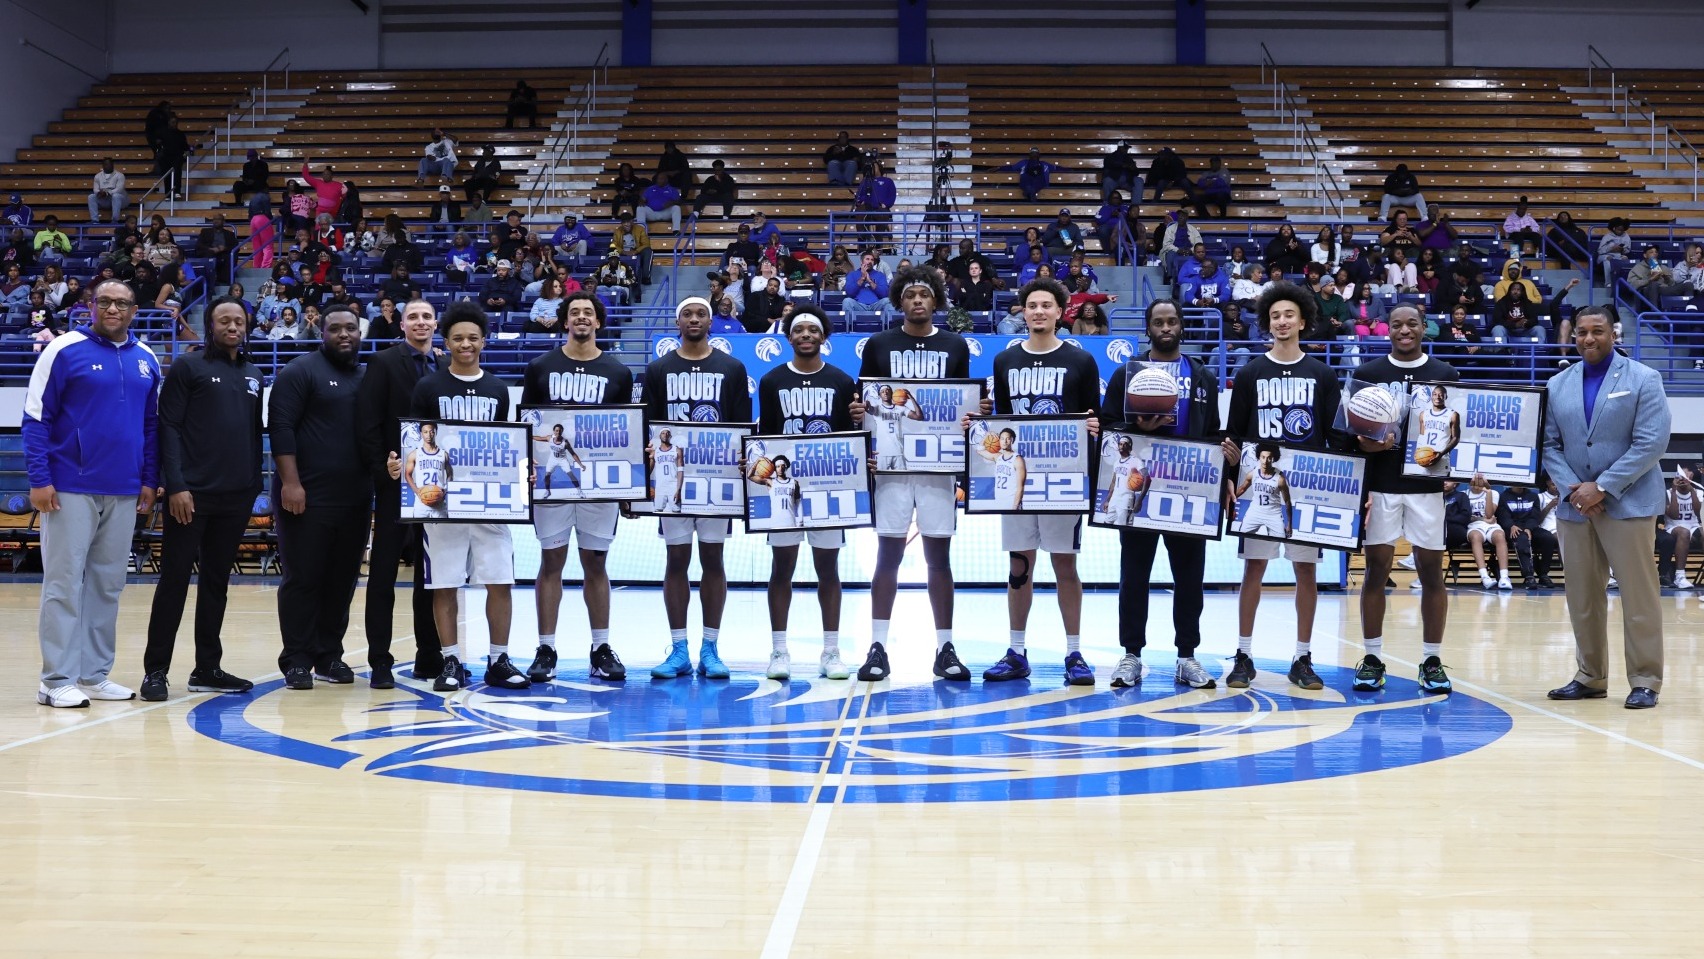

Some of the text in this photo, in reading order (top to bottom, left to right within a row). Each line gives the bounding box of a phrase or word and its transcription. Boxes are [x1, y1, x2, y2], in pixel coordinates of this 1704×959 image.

[889, 350, 949, 379] DOUBT
[548, 372, 609, 404] DOUBT
[666, 372, 725, 402] DOUBT
[1008, 367, 1068, 397] DOUBT
[1256, 377, 1316, 407] DOUBT
[438, 396, 498, 420] DOUBT
[778, 387, 836, 418] DOUBT
[916, 388, 963, 406] OMARI
[1011, 398, 1030, 414] US
[1466, 393, 1522, 414] DARIUS
[574, 413, 628, 432] ROMEO
[667, 402, 690, 421] US
[922, 405, 957, 422] BYRD
[1257, 407, 1283, 438] US
[1465, 411, 1520, 431] BOBEN
[888, 422, 895, 433] 5
[1018, 424, 1078, 441] MATHIAS
[1426, 431, 1438, 446] 12
[458, 431, 510, 450] TOBIAS
[573, 430, 629, 449] AQUINO
[687, 431, 733, 449] LARRY
[903, 434, 965, 463] 05
[1017, 441, 1079, 459] BILLINGS
[450, 447, 519, 467] SHIFFLET
[683, 447, 739, 466] HOWELL
[794, 441, 855, 461] EZEKIEL
[1150, 442, 1212, 468] TERRELL
[1455, 441, 1532, 476] 12
[573, 460, 632, 490] 10
[790, 458, 859, 478] CANNEDY
[1142, 459, 1219, 485] WILLIAMS
[1292, 454, 1354, 478] IBRAHIM
[423, 472, 438, 486] 24
[1023, 472, 1085, 503] 22
[1282, 469, 1360, 496] KOUROUMA
[447, 481, 525, 513] 24
[681, 477, 744, 506] 00
[1258, 494, 1270, 506] 13
[781, 497, 788, 510] 11
[802, 489, 857, 520] 11
[1147, 489, 1208, 526] 01
[1294, 501, 1355, 539] 13
